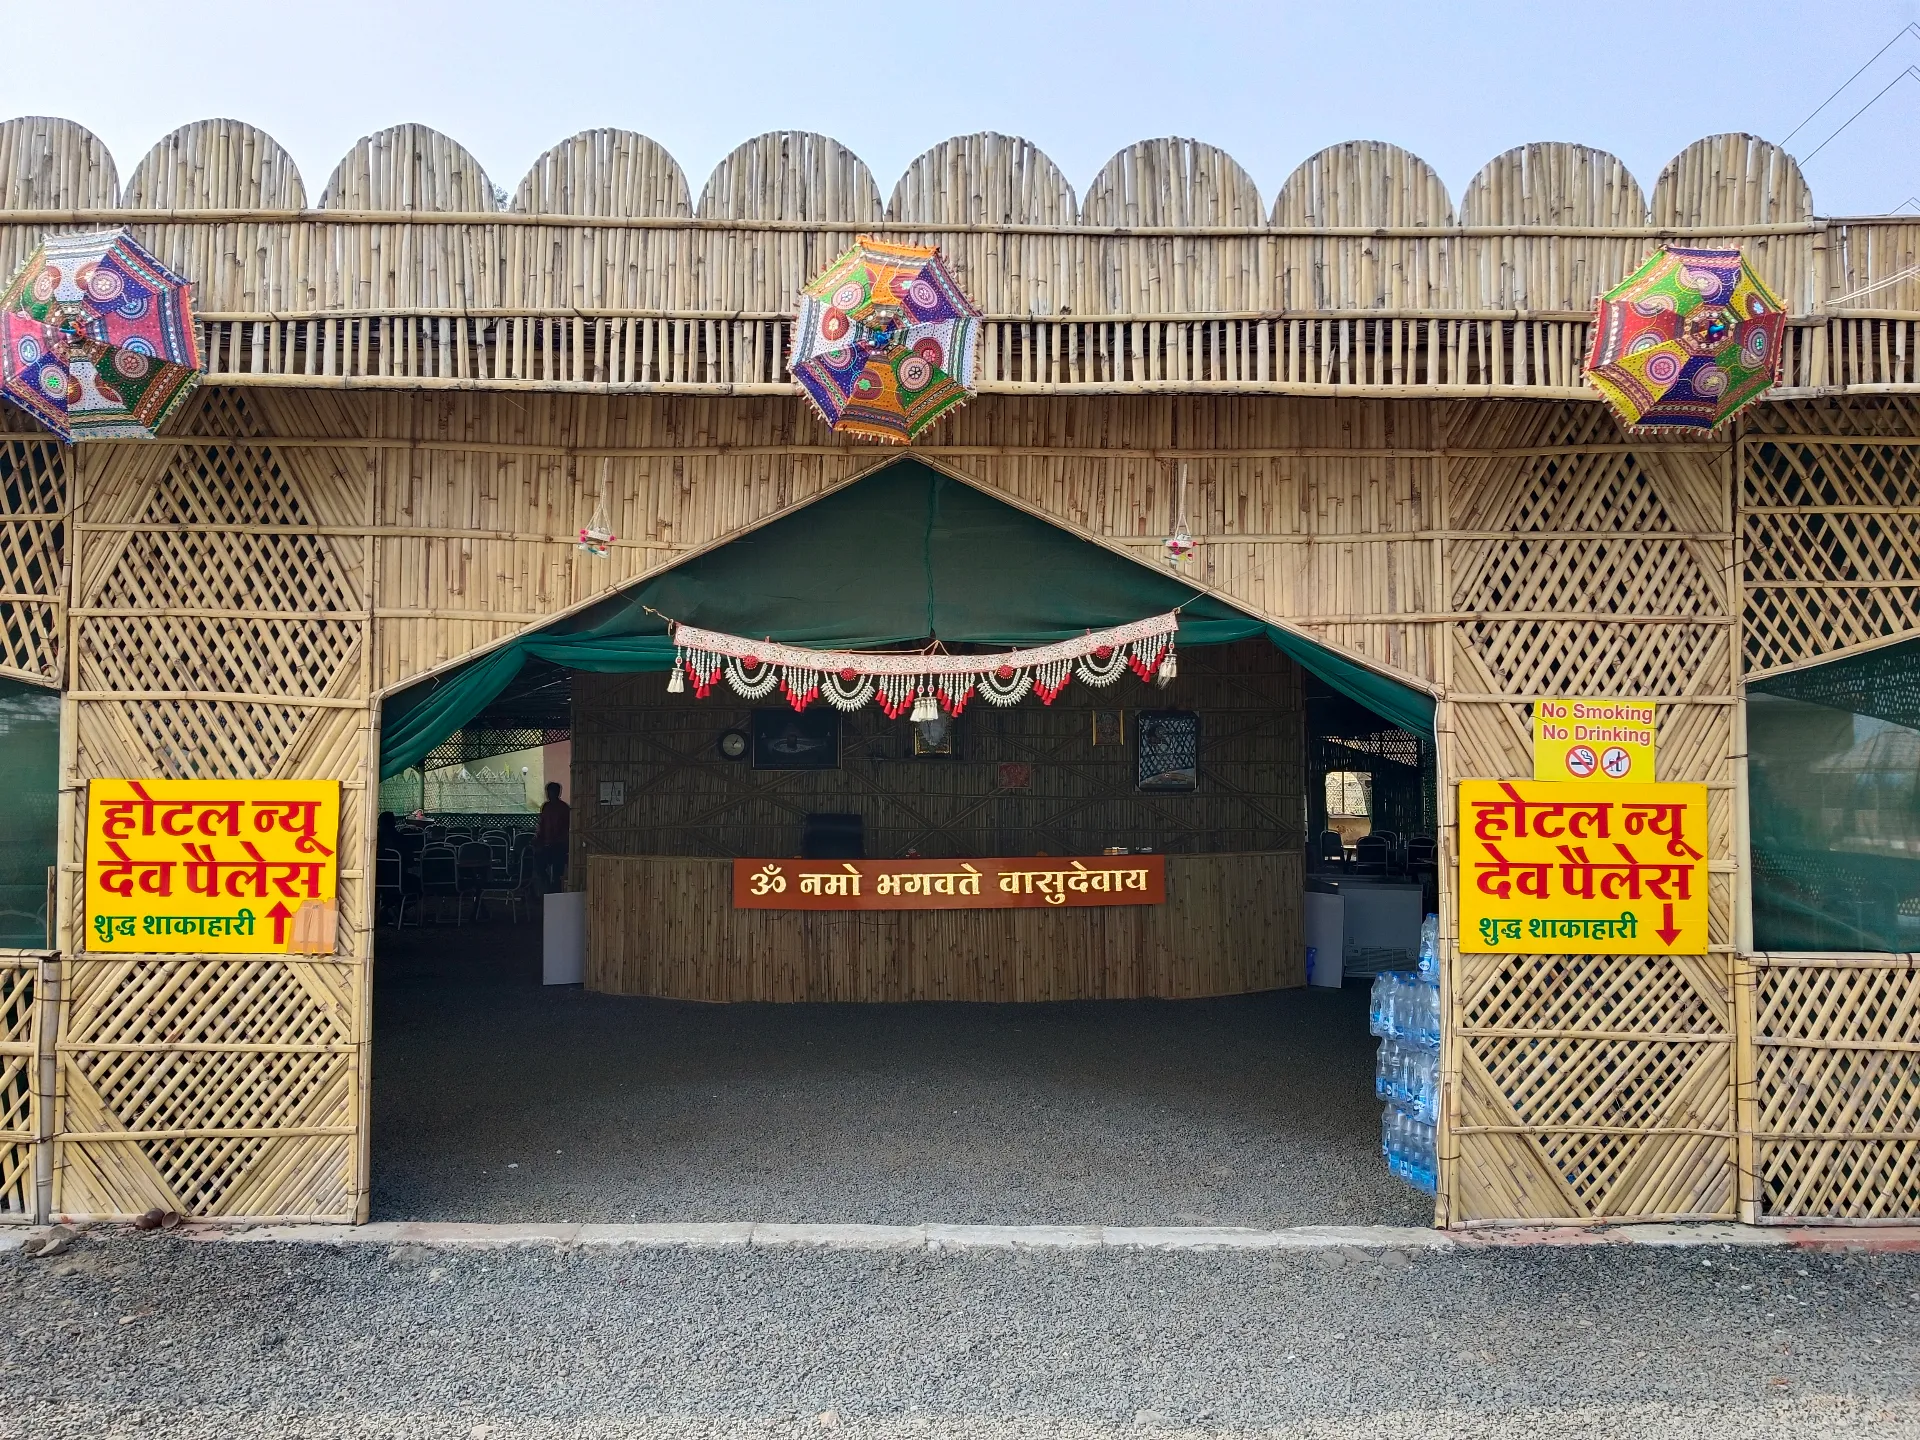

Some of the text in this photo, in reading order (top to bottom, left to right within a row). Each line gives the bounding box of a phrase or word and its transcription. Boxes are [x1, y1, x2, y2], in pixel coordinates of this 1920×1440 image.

[1541, 702, 1653, 724] No Smoking
[1543, 725, 1651, 746] No Drinking
[100, 781, 334, 857] होटल न्यू
[1471, 783, 1704, 861] होटल न्यू
[98, 841, 326, 898] देव पैलेस
[799, 864, 862, 896] नमो
[877, 863, 982, 896] भगवते
[998, 861, 1148, 905] वासुदेवाय
[1475, 843, 1694, 900] देव पैलेस
[94, 908, 255, 943] शुद्ध शाकाहारी
[1479, 911, 1638, 945] शुद्ध शाकाहारी
